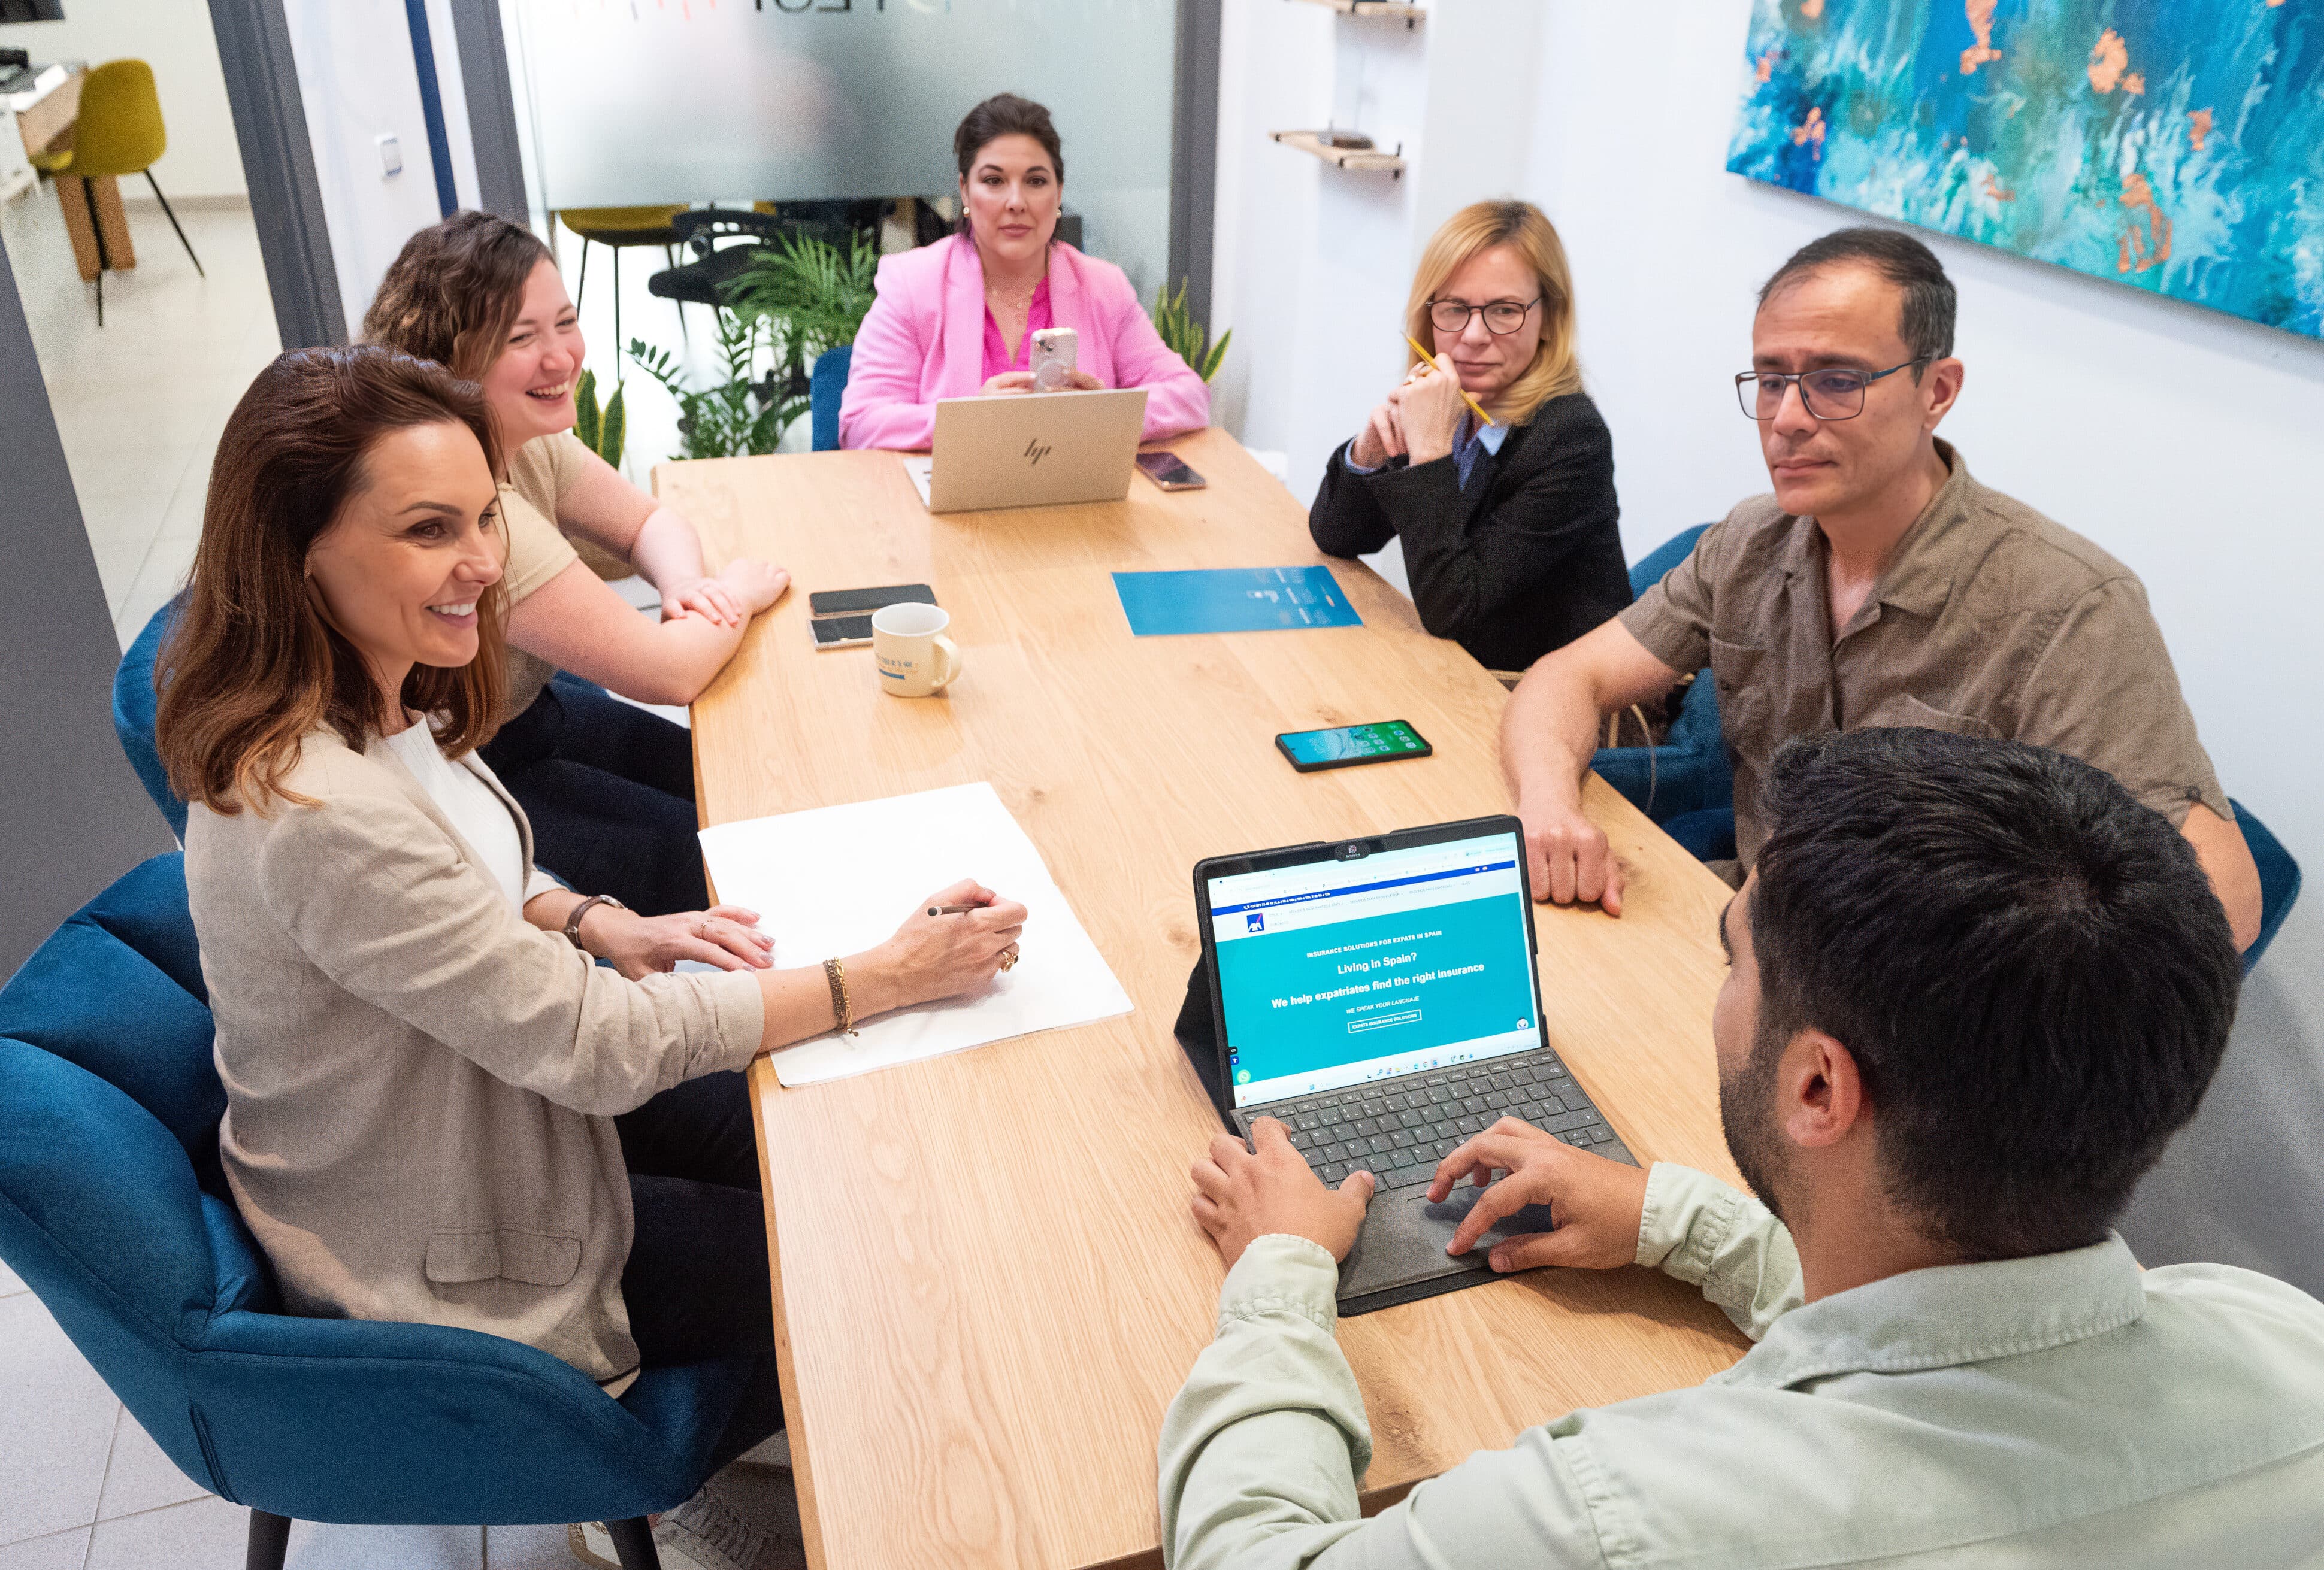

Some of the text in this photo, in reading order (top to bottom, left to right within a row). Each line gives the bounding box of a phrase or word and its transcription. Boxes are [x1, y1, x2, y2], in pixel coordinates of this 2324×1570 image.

[1306, 947, 1342, 958] INSURANCE
[1343, 941, 1378, 952] SOLUTIONS
[1393, 934, 1416, 944] EXPATS
[1424, 930, 1442, 938] SPAIN
[1337, 951, 1417, 974] Living in Spain?
[1271, 963, 1485, 1008] We help expatriates find the right insurance
[1356, 1004, 1375, 1013] SPEAK
[1391, 996, 1420, 1006] LANGUAJE
